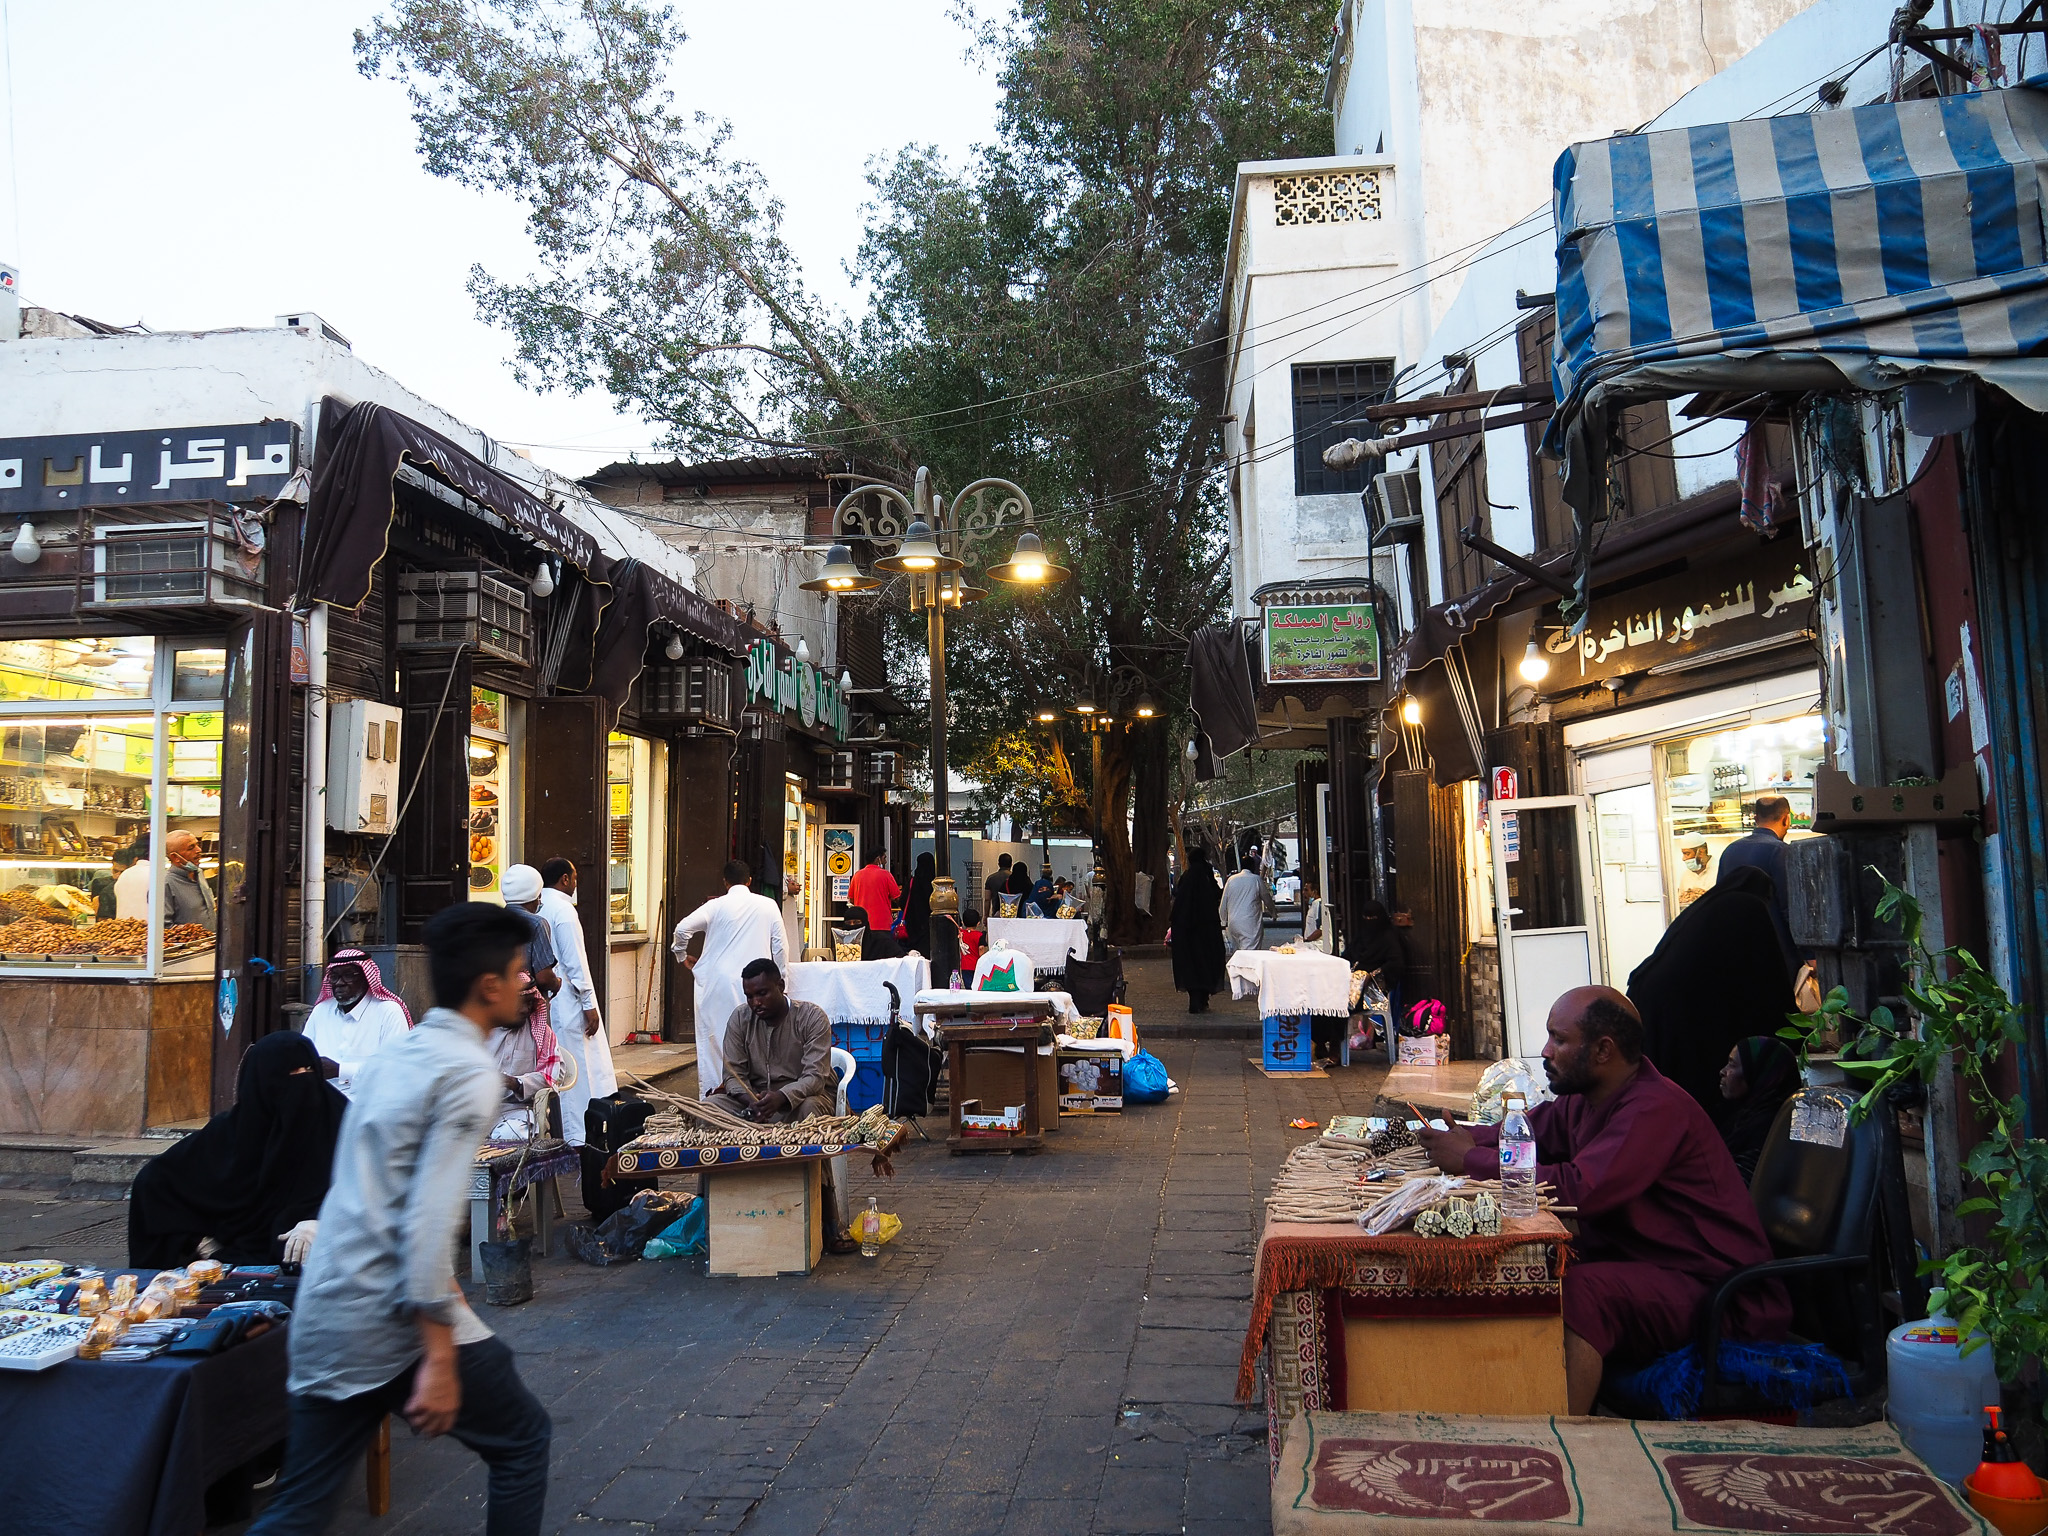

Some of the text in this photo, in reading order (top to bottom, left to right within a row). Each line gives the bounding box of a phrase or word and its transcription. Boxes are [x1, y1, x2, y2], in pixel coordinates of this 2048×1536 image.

[43, 445, 133, 498] باب
[151, 437, 290, 490] مركز
[1271, 611, 1372, 633] روائع المملكة
[1583, 607, 1664, 664] الفاخرة
[1667, 580, 1756, 644] للتمور
[1296, 648, 1348, 662] للتمور الفاخرة
[1415, 1455, 1553, 1477] الفرسان
